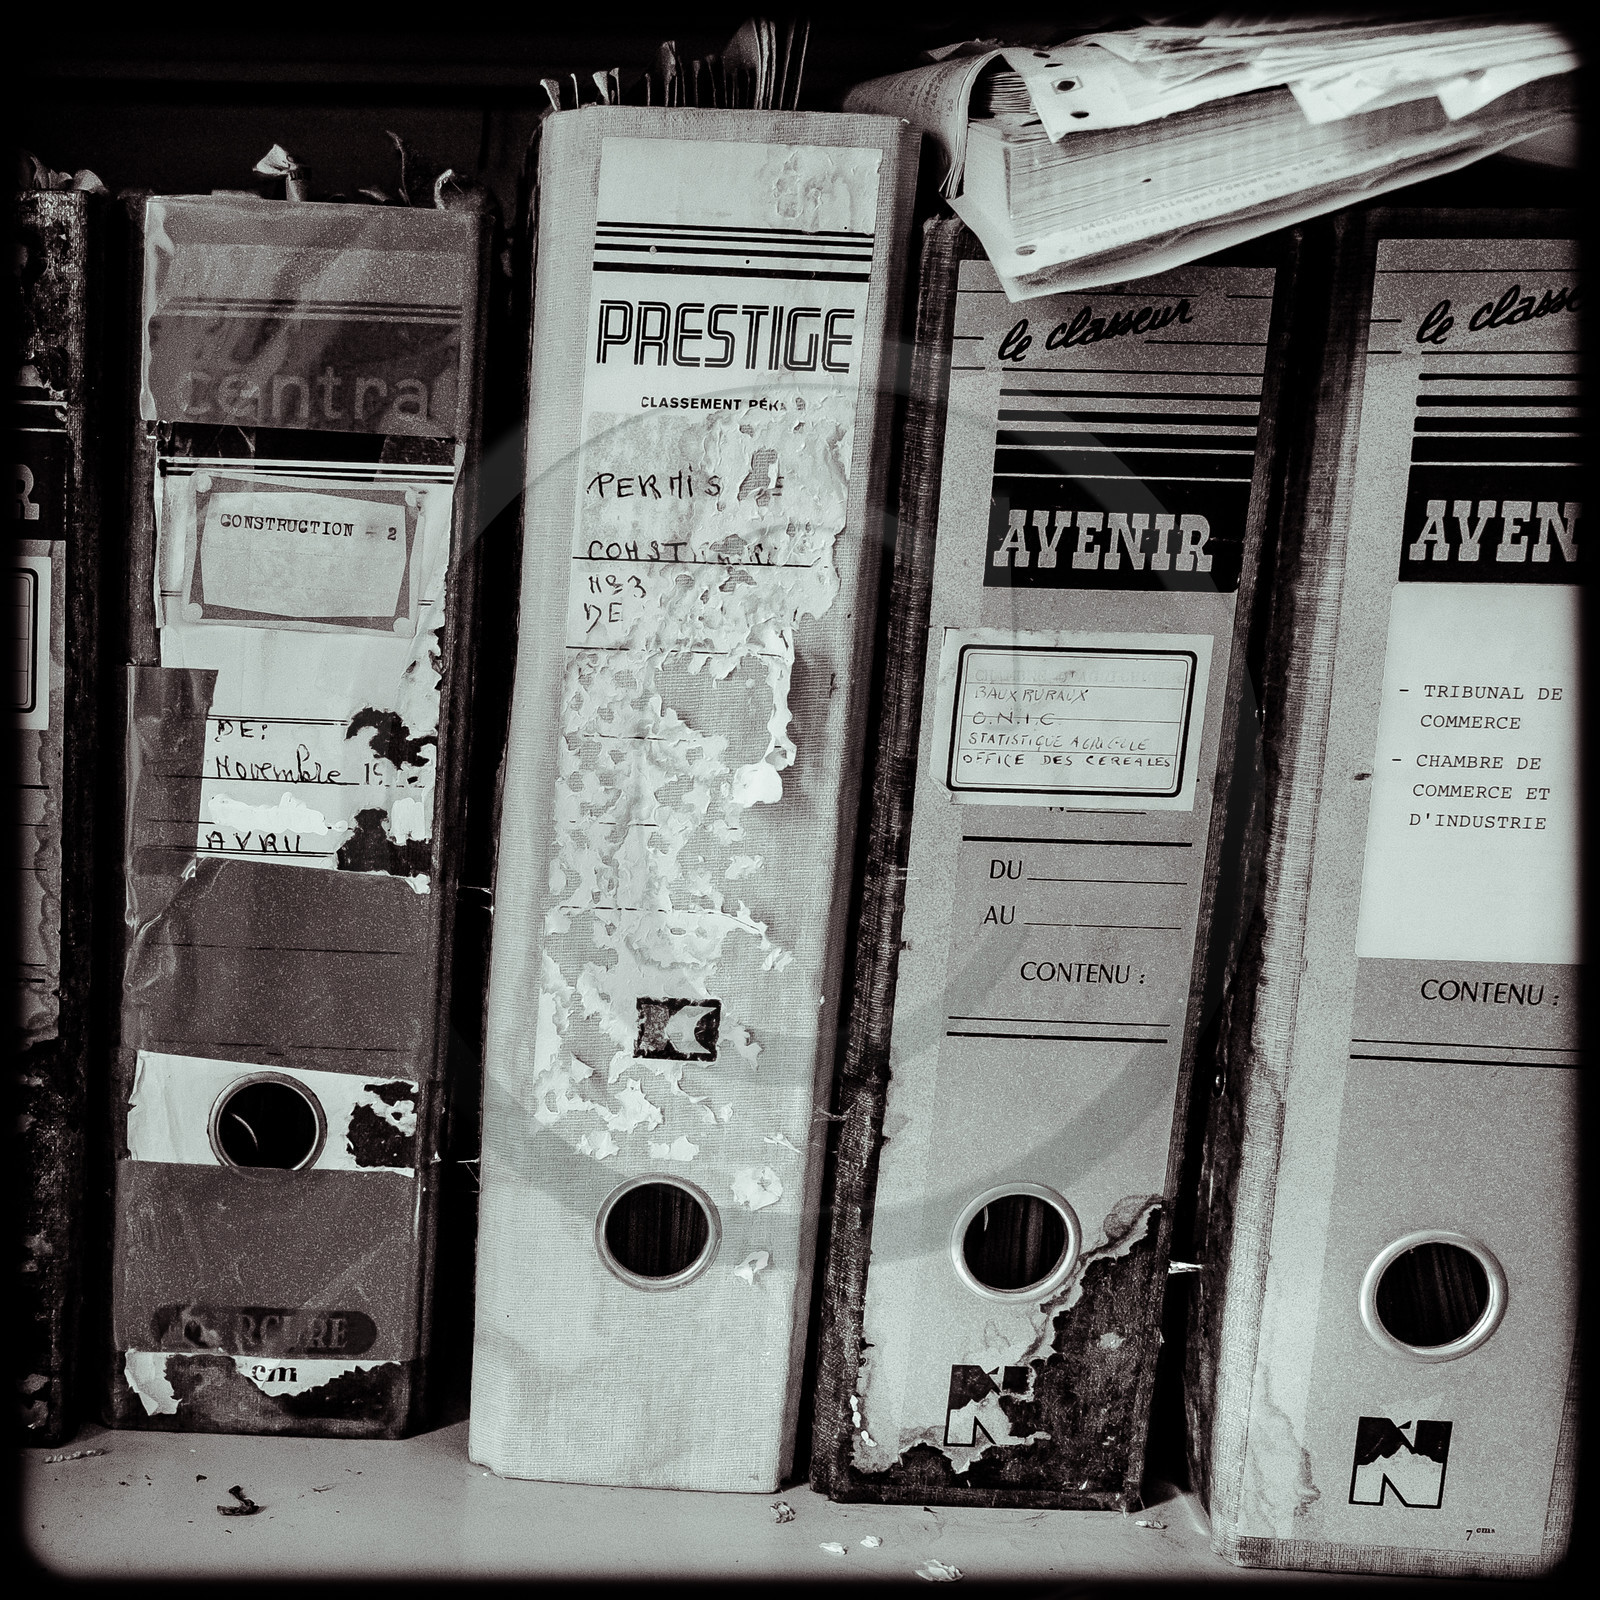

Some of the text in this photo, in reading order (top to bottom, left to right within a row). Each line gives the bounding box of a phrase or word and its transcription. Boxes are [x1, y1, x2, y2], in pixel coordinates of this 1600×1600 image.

[998, 300, 1193, 362] le classeur
[1416, 299, 1454, 344] le
[596, 299, 855, 373] PRESTIGE
[641, 397, 742, 410] CLASSEMENT
[220, 513, 354, 537] CONSTRUCTION
[387, 527, 397, 541] 2
[993, 509, 1213, 572] AVENIR
[1424, 684, 1524, 701] TRIBUNAL
[1538, 686, 1563, 701] DE
[1420, 714, 1521, 730] COMMERCE
[963, 752, 1171, 768] OFFICE DES CEREALES
[1416, 754, 1503, 770] CHAMBRE
[1516, 757, 1541, 770] DE
[1412, 783, 1550, 801] COMMERCE ET
[1409, 813, 1546, 830] D'INDUSTRIE
[990, 860, 1023, 880] DU
[984, 906, 1016, 925] AU
[1020, 961, 1131, 984] CONTENU
[1420, 979, 1544, 1006] CONTENU
[1465, 1529, 1473, 1541] 7
